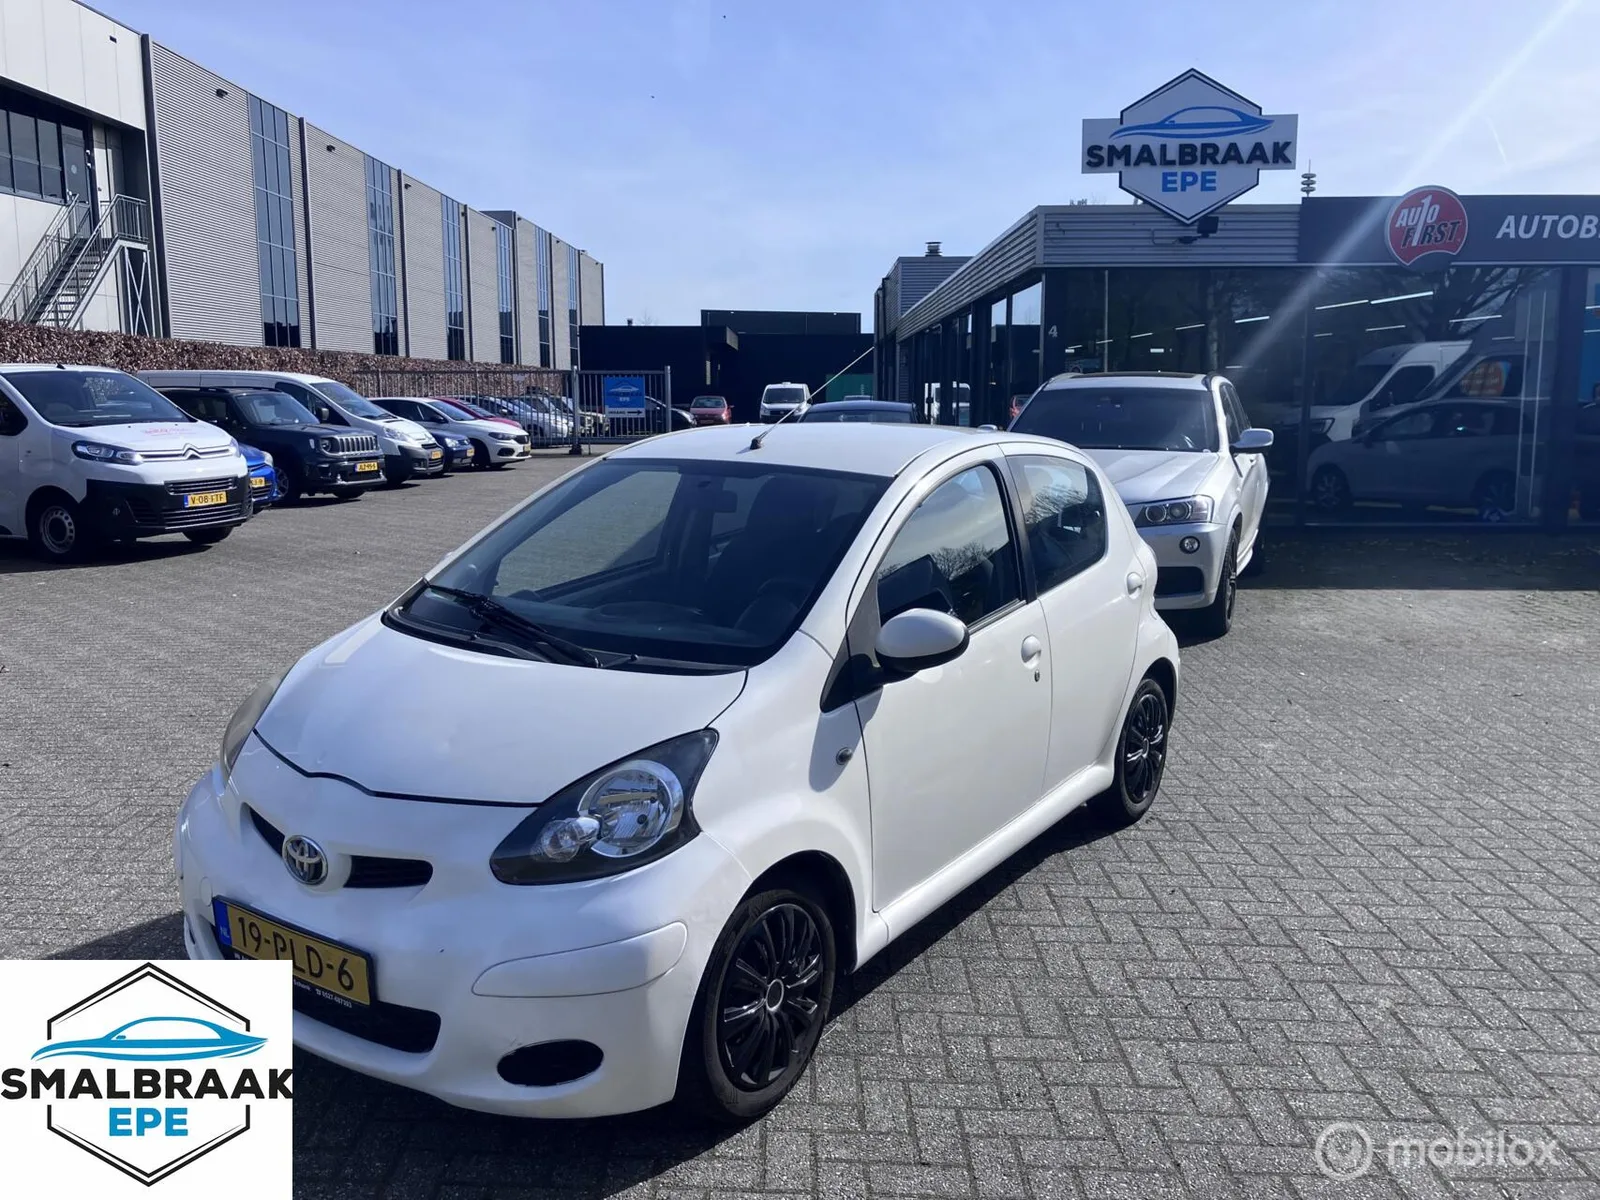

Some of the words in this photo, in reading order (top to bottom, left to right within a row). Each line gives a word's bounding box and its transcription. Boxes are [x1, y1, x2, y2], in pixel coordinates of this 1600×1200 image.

[1085, 141, 1292, 168] SMALBRAAK
[1161, 171, 1217, 193] EPE
[1495, 214, 1600, 239] AUTOB
[1048, 325, 1058, 338] 4
[238, 916, 354, 992] 19-PLD-6
